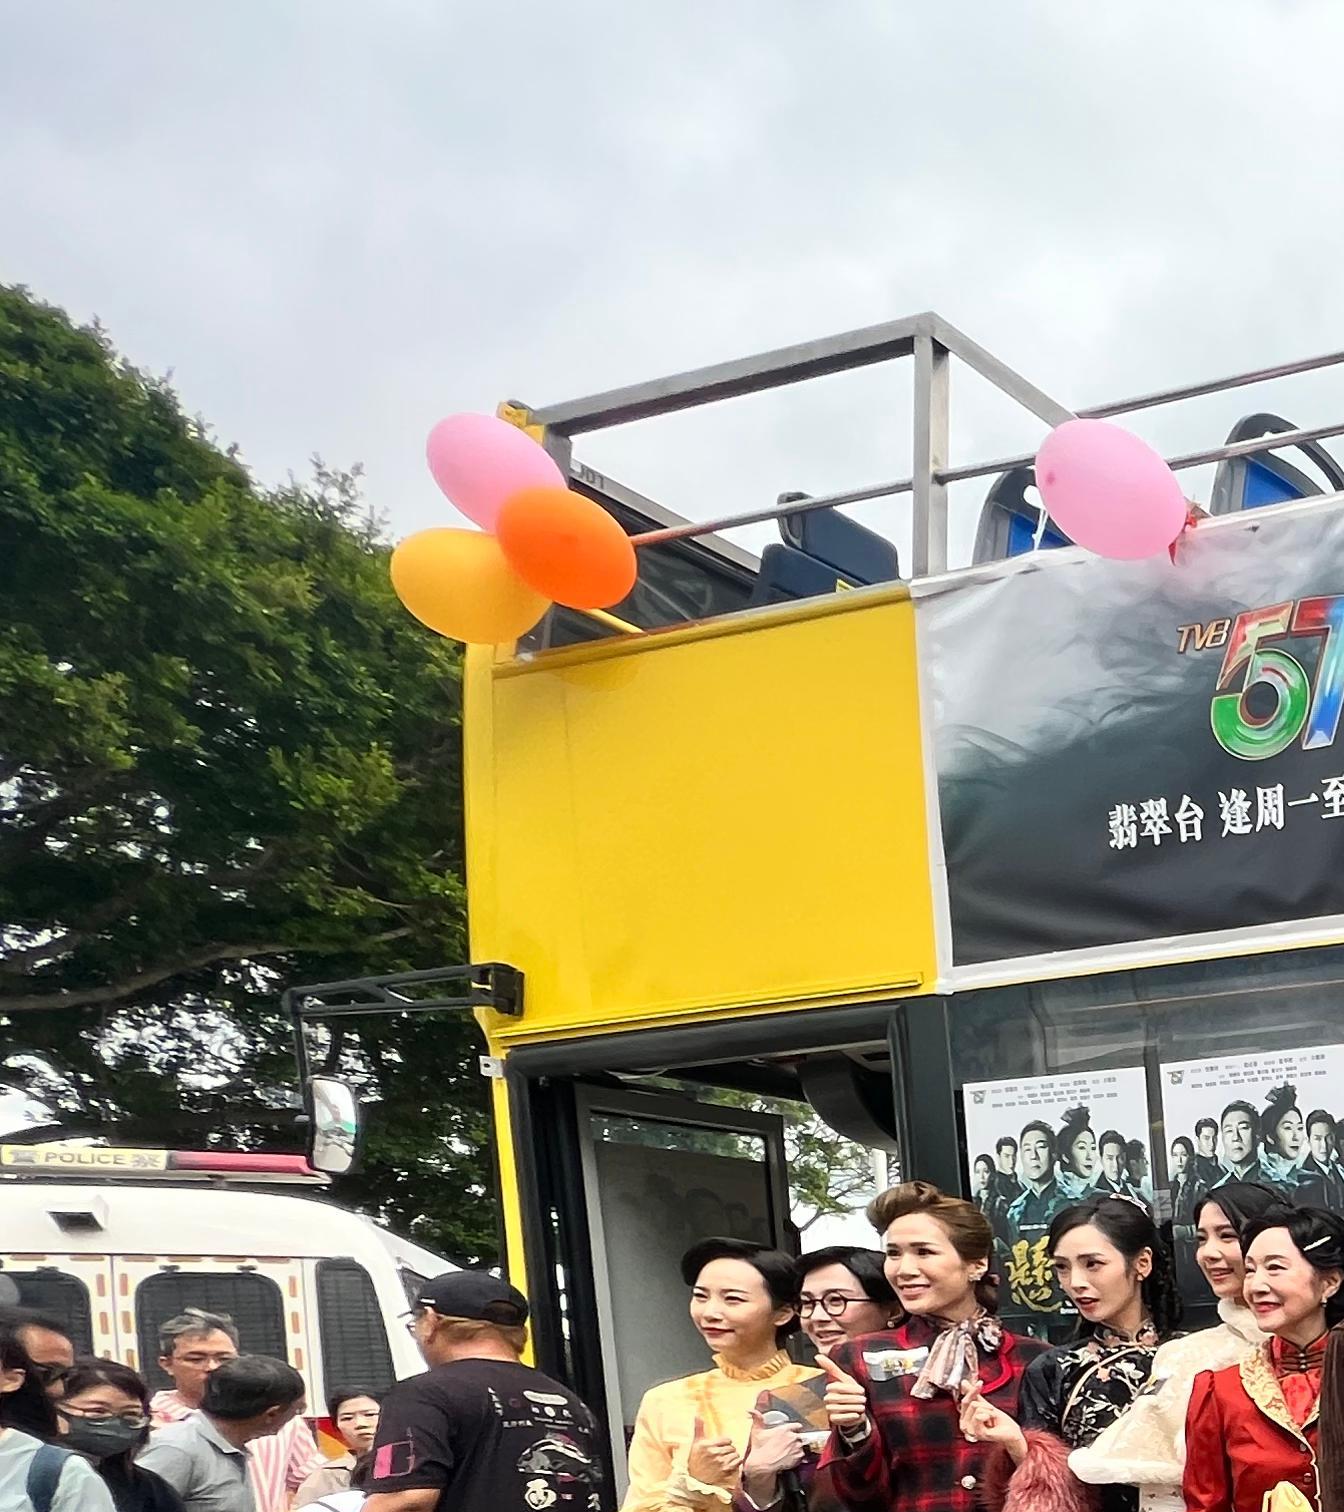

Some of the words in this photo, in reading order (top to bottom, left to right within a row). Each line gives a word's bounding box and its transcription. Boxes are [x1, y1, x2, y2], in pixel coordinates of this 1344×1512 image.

[1176, 617, 1231, 654] TVB
[1108, 794, 1205, 850] 翡翠台
[44, 1151, 128, 1165] POLICE
